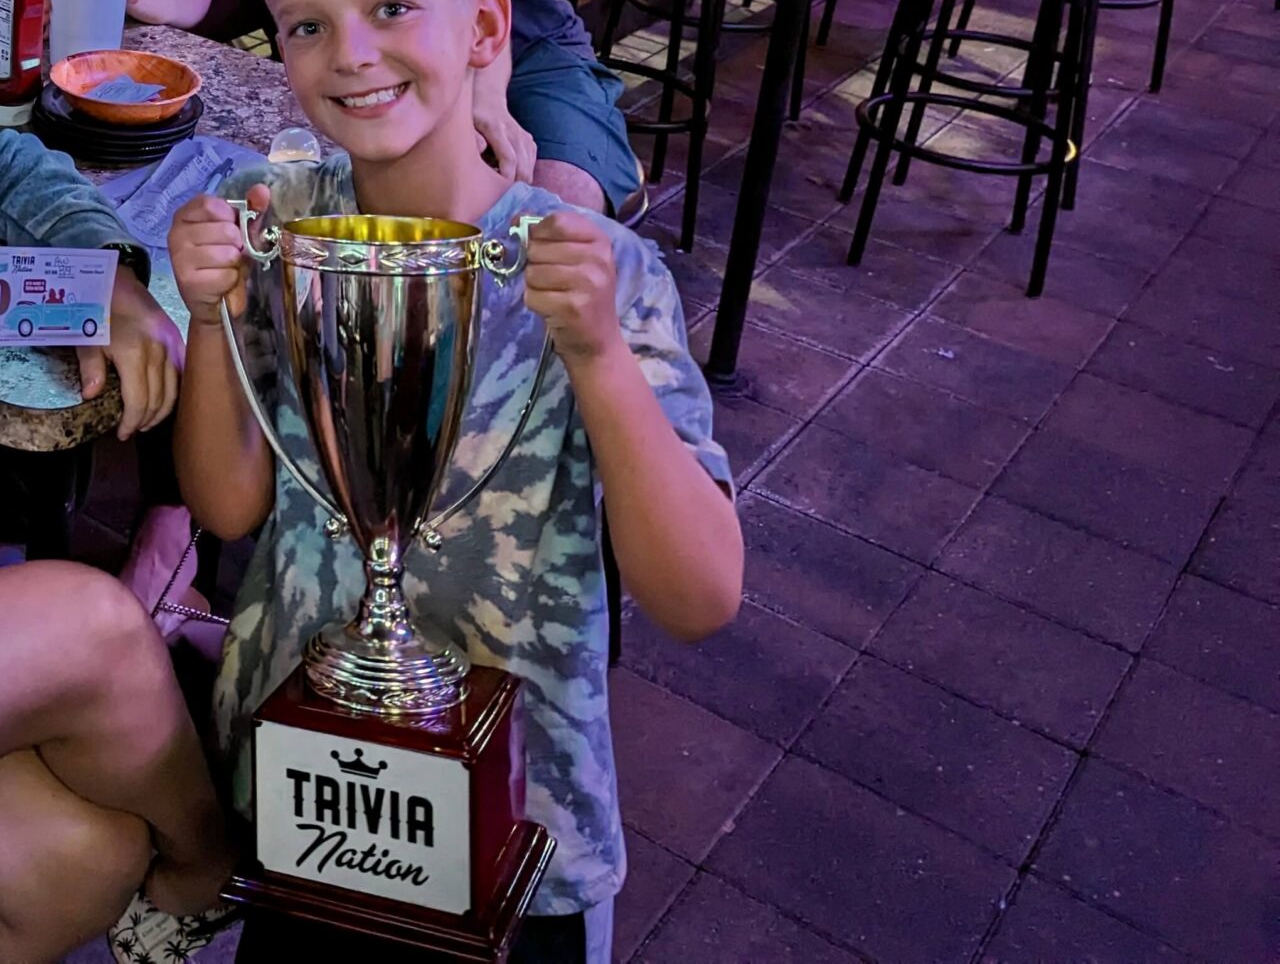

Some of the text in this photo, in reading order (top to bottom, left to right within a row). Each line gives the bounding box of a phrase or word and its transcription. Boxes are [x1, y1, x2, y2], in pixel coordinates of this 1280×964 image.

[12, 255, 35, 266] TRIVIA
[286, 767, 434, 848] TRIVIA
[295, 823, 430, 886] Nation
